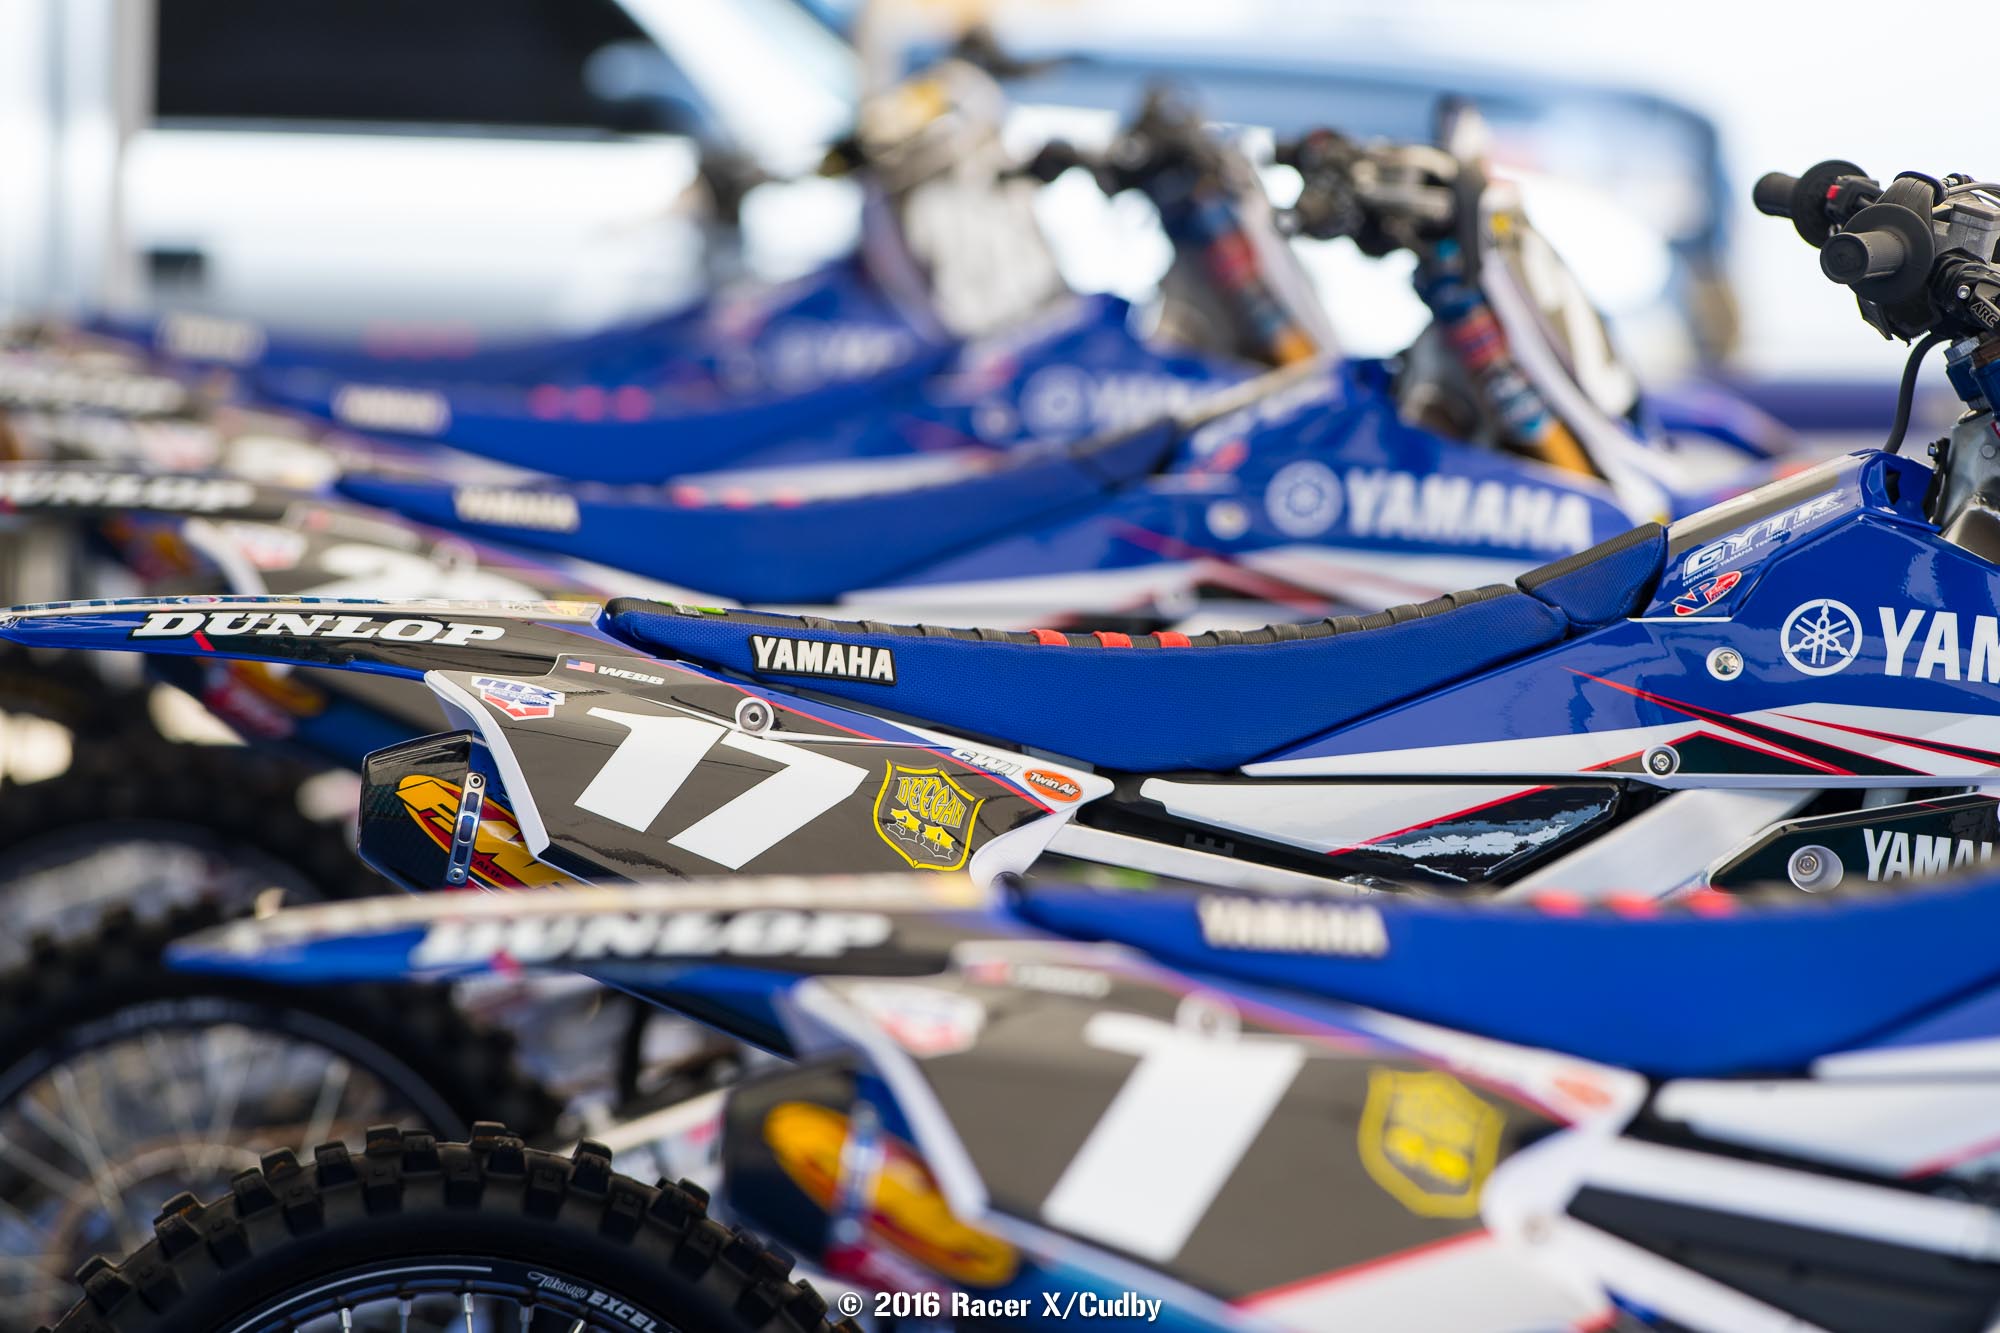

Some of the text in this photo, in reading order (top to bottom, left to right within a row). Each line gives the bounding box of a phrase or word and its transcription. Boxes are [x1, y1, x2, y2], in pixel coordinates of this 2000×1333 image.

[1970, 301, 1999, 328] ARC
[1345, 466, 1592, 551] YAMAHA
[1683, 489, 1844, 580] GYTR
[1671, 576, 1719, 612] VP
[132, 612, 506, 646] DUNLOP
[598, 665, 665, 685] WEBB
[752, 635, 895, 682] YAMAHA
[574, 706, 870, 871] 17
[895, 776, 967, 829] DEEGAN
[1029, 771, 1081, 797] Twin Air
[409, 911, 892, 968] DUNLOP
[527, 1271, 659, 1333] Takasago EXCEL
